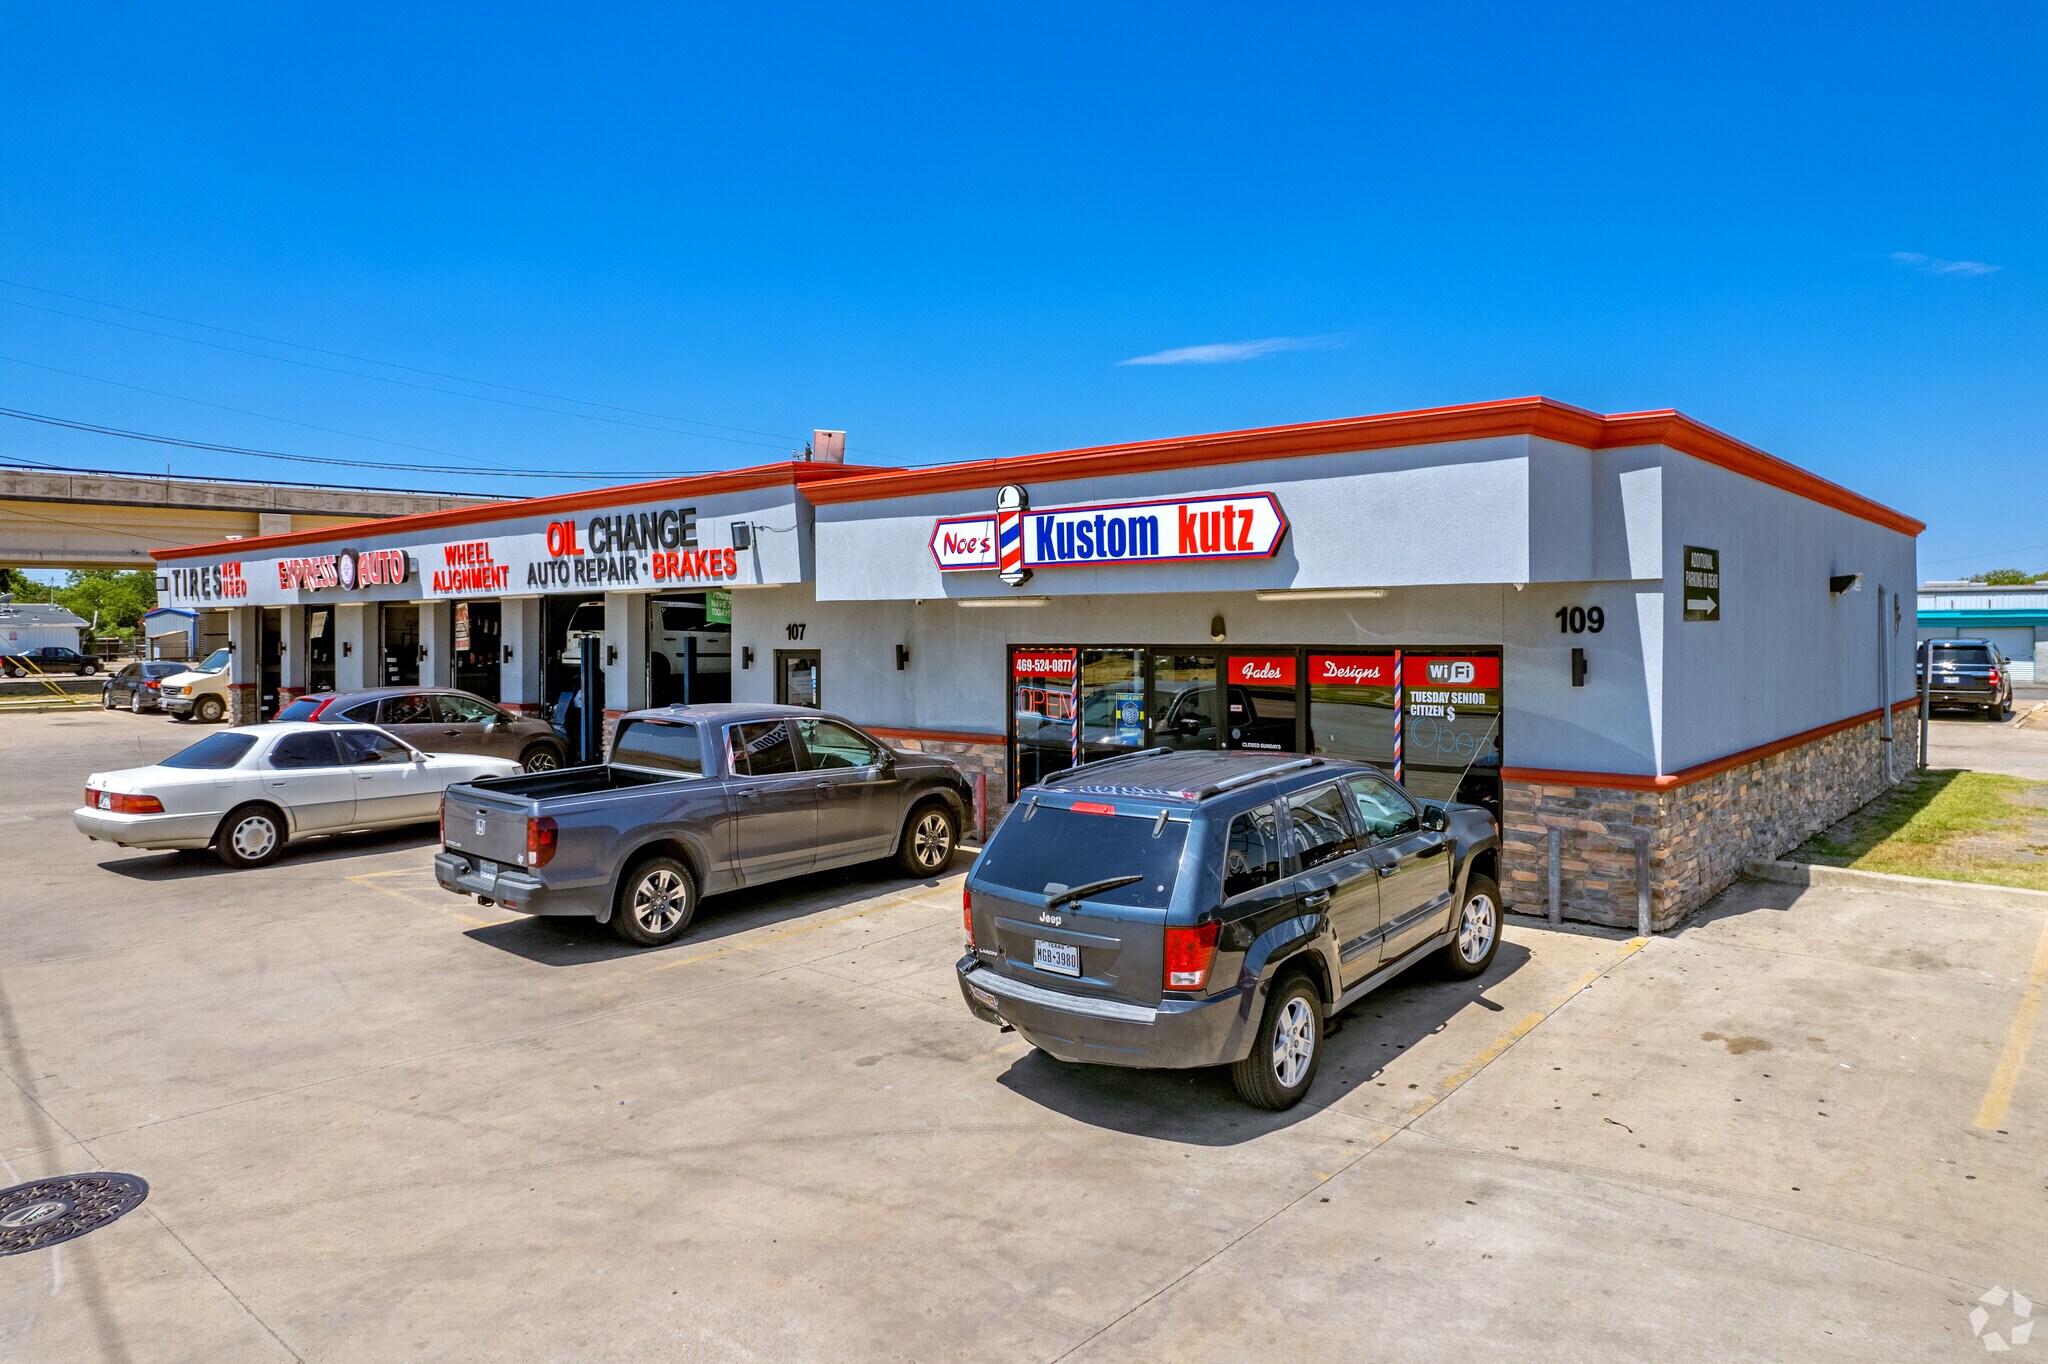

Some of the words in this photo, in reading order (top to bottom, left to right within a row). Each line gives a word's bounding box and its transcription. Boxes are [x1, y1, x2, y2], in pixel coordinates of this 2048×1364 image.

[546, 520, 584, 558] OIL
[588, 507, 698, 552] CHANGE
[943, 531, 991, 556] Noe's
[1036, 514, 1159, 562] Kustom
[1178, 505, 1254, 555] kutz
[444, 542, 494, 567] WHEEL
[527, 559, 570, 586] AUTO
[574, 556, 638, 583] REPAIR
[652, 547, 737, 579] BRAKES
[222, 562, 242, 578] NEW
[278, 556, 338, 592] EXPRESS
[358, 550, 408, 589] AUTO
[432, 565, 509, 591] ALIGNMENT
[172, 566, 222, 600] TIRES
[222, 579, 247, 597] USED
[786, 623, 806, 640] 107
[1555, 606, 1605, 633] 109
[1016, 658, 1072, 672] 469-524-0877
[1242, 661, 1281, 680] Fades
[1323, 661, 1380, 684] Designs
[1019, 688, 1074, 720] OPEN
[1410, 691, 1450, 703] TUESDAY
[1451, 692, 1486, 705] SENIOR
[1410, 705, 1444, 717] CITIZEN
[1447, 705, 1456, 722] $
[1411, 716, 1492, 763] Open
[1039, 912, 1062, 926] Jeep
[1048, 942, 1065, 950] TEXAS
